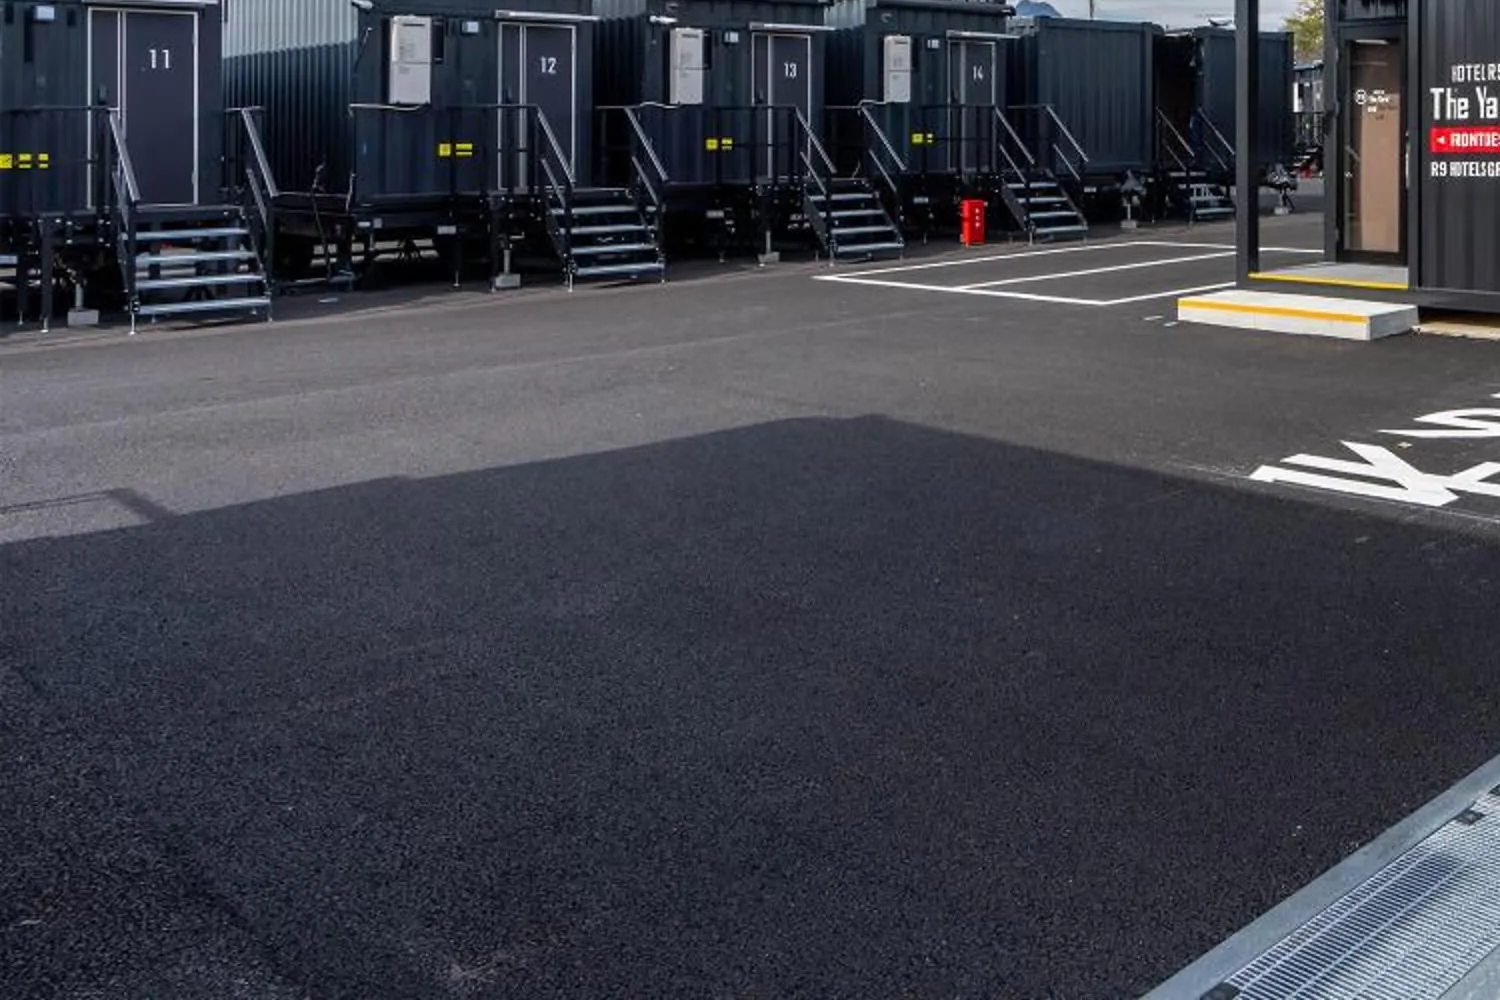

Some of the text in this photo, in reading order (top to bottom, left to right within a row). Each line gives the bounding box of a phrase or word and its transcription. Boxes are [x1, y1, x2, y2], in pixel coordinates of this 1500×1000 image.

[149, 49, 169, 69] 11
[540, 56, 557, 74] 12
[783, 61, 797, 78] 13
[1430, 87, 1469, 120] The
[1431, 162, 1447, 176] R9
